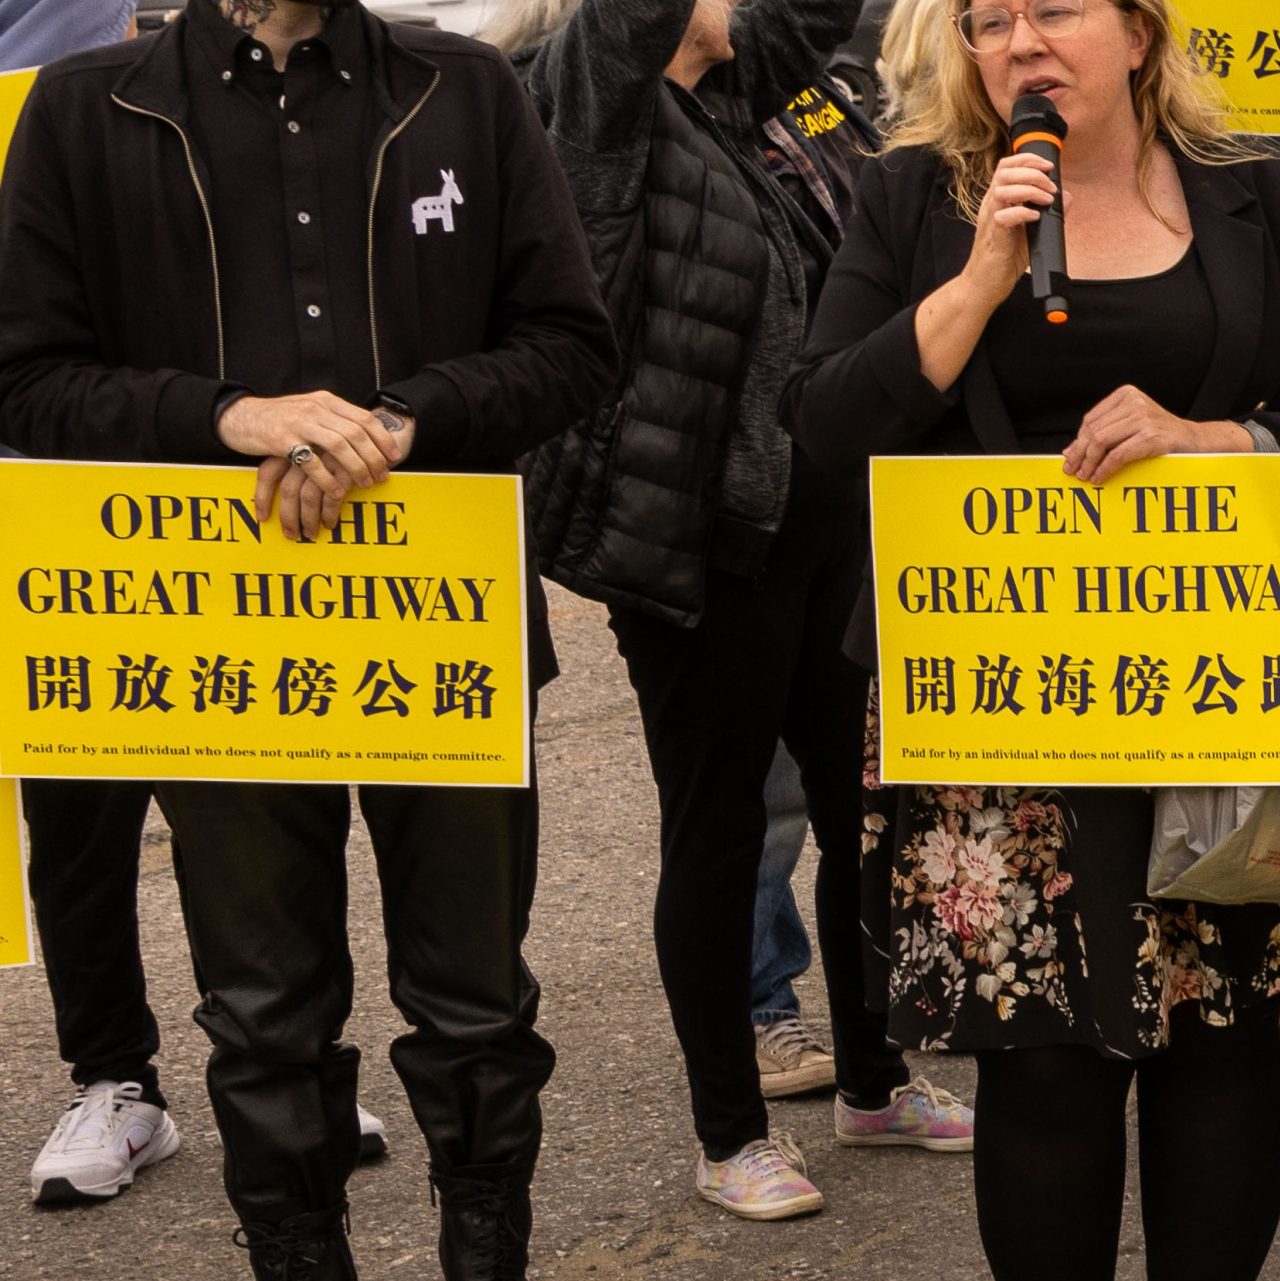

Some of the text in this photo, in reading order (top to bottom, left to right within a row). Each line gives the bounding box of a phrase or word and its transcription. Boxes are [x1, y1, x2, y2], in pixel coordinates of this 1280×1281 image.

[101, 493, 408, 545] OPEN HE
[963, 486, 1237, 535] OPEN THE
[18, 568, 495, 622] GREAT HIGHWAY
[898, 566, 1055, 613] GREAT
[26, 654, 497, 719] 開放海傍公路
[23, 743, 505, 762] Paid for by an individual who does not qualify as a campaign committee.
[902, 747, 926, 758] Paid
[929, 748, 946, 759] for
[948, 748, 961, 761] by
[964, 751, 978, 759] an
[981, 749, 1039, 760] individual
[1042, 749, 1066, 760] who
[1069, 749, 1097, 760] does
[1100, 751, 1120, 760] not
[1123, 749, 1165, 762] qualify
[1170, 752, 1184, 760] as
[1187, 752, 1195, 760] a
[1198, 749, 1257, 762] campaign
